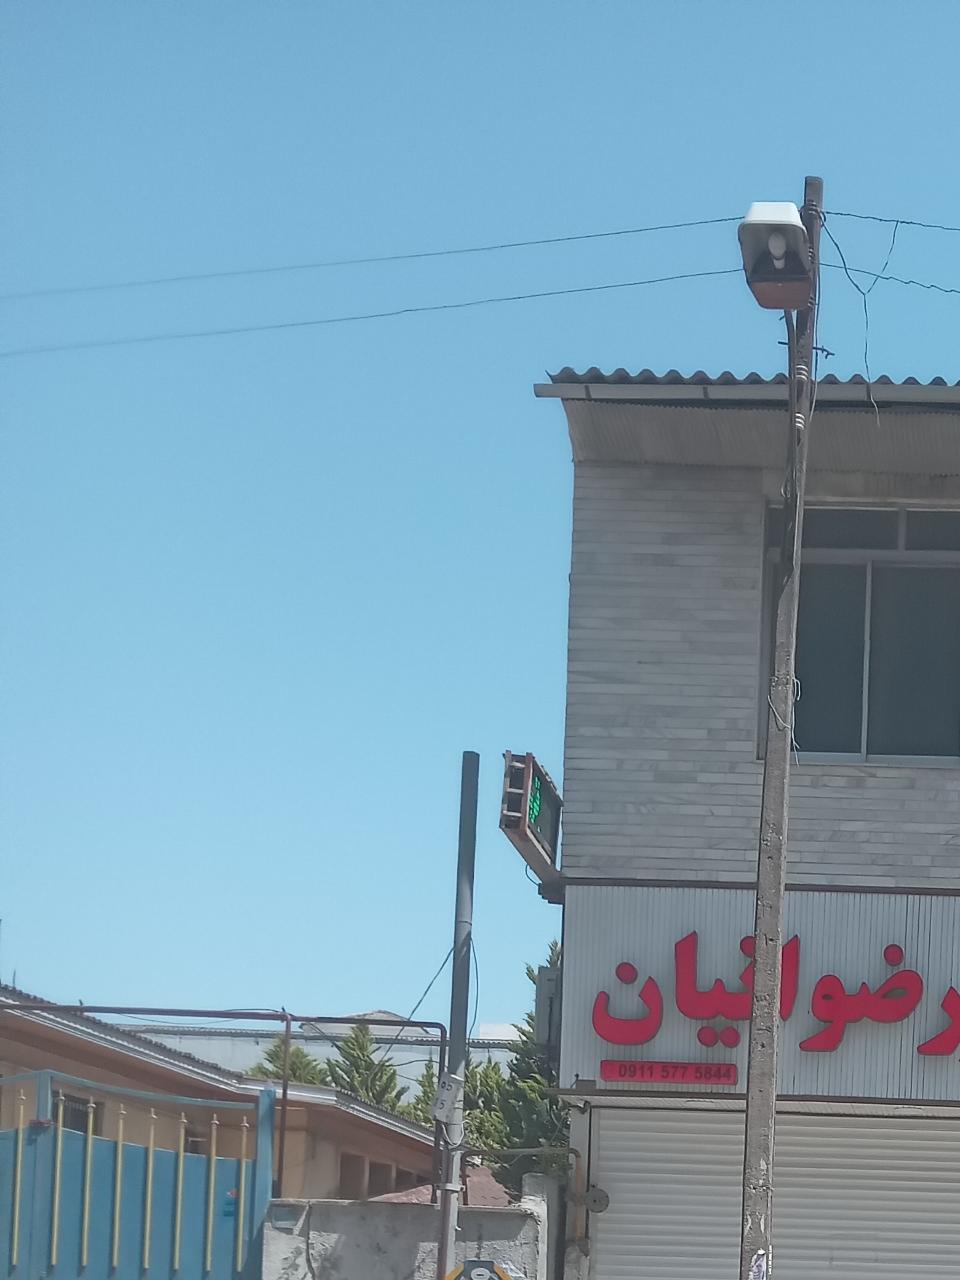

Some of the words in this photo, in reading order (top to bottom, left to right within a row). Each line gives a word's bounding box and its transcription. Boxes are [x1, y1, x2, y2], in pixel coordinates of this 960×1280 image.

[618, 1063, 654, 1078] 0911
[660, 1065, 689, 1079] 577
[694, 1066, 732, 1081] 5844
